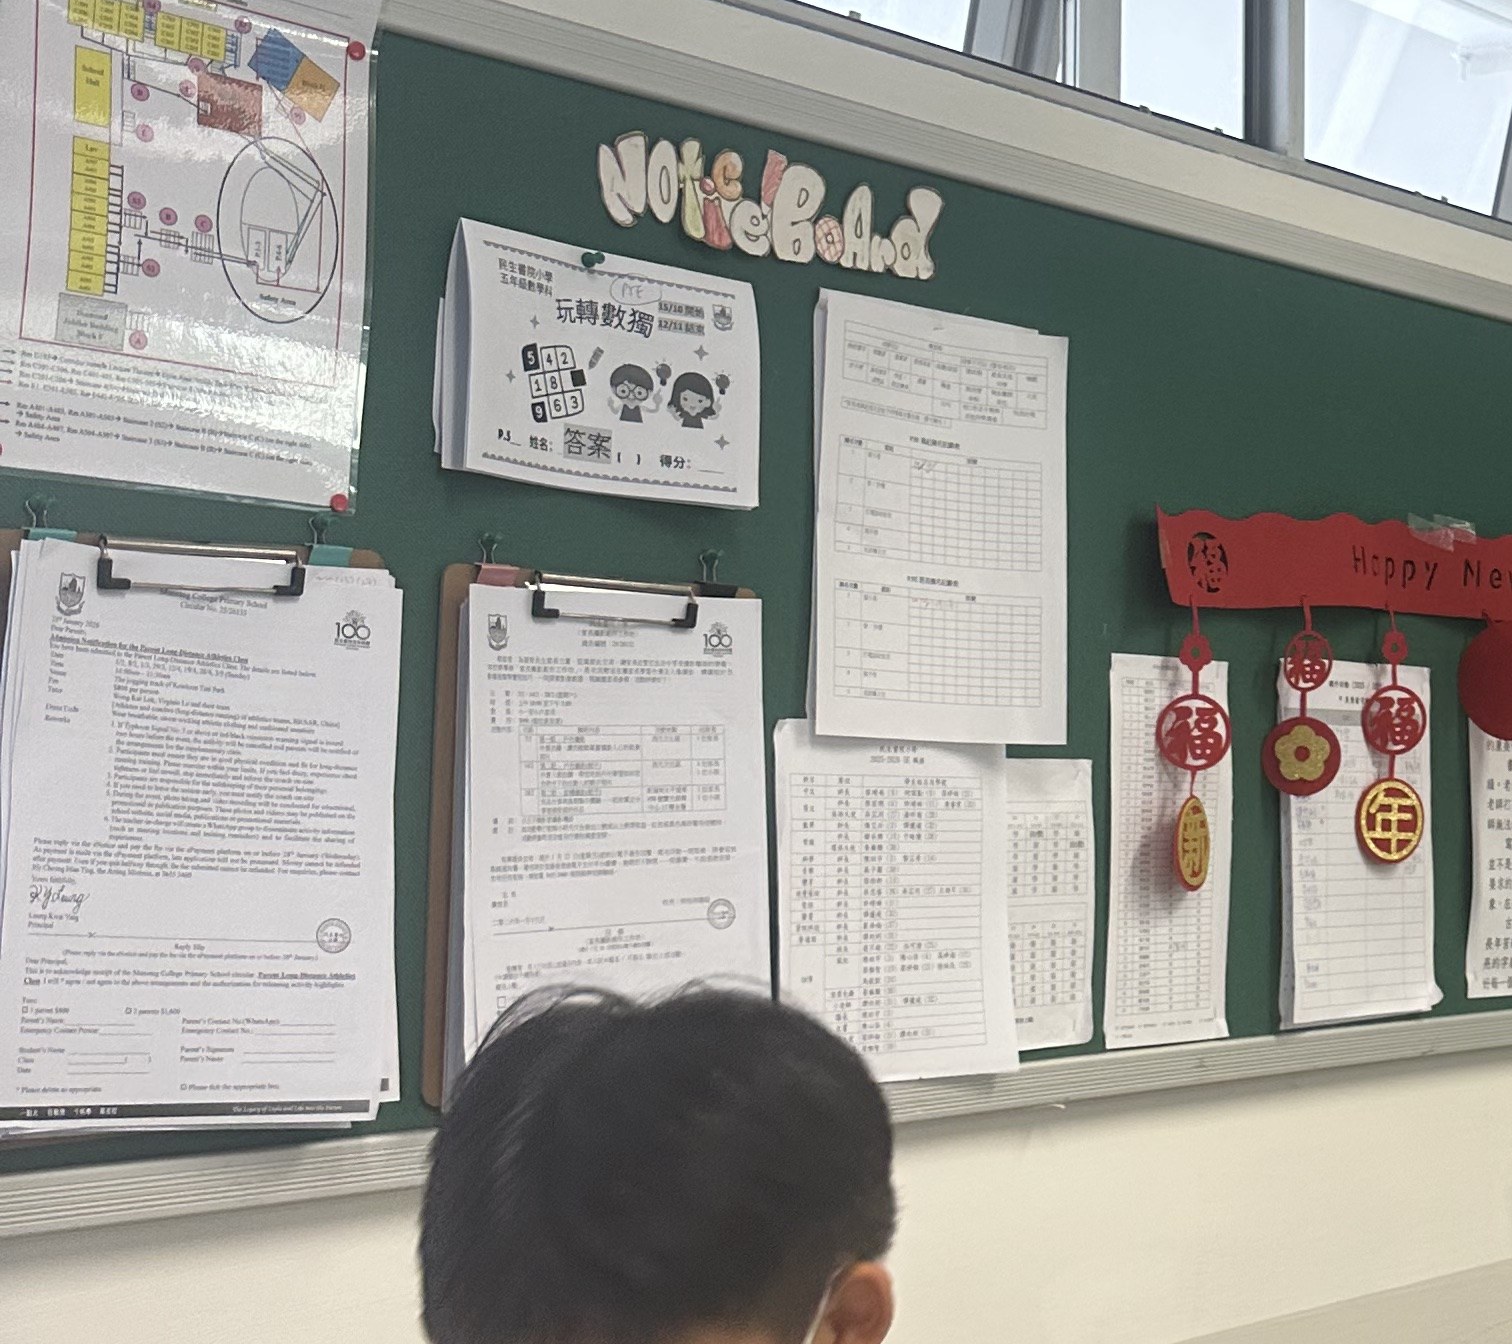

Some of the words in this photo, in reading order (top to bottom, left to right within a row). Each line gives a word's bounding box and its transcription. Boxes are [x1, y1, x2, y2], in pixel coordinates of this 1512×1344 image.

[498, 258, 553, 282] 民生書院小學
[499, 273, 553, 297] 五年級數學科
[555, 298, 655, 338] 玩轉數獨
[527, 350, 536, 365] 5
[546, 353, 553, 366] 4
[560, 352, 568, 365] 2
[534, 378, 542, 392] 1
[550, 376, 559, 390] 8
[534, 405, 544, 419] 9
[553, 398, 562, 413] 6
[571, 395, 579, 409] 3
[564, 426, 612, 458] 答案
[335, 622, 371, 641] 100
[703, 633, 733, 649] 100
[1371, 695, 1420, 748] 福
[1164, 705, 1224, 764] 福
[1366, 790, 1418, 860] 年
